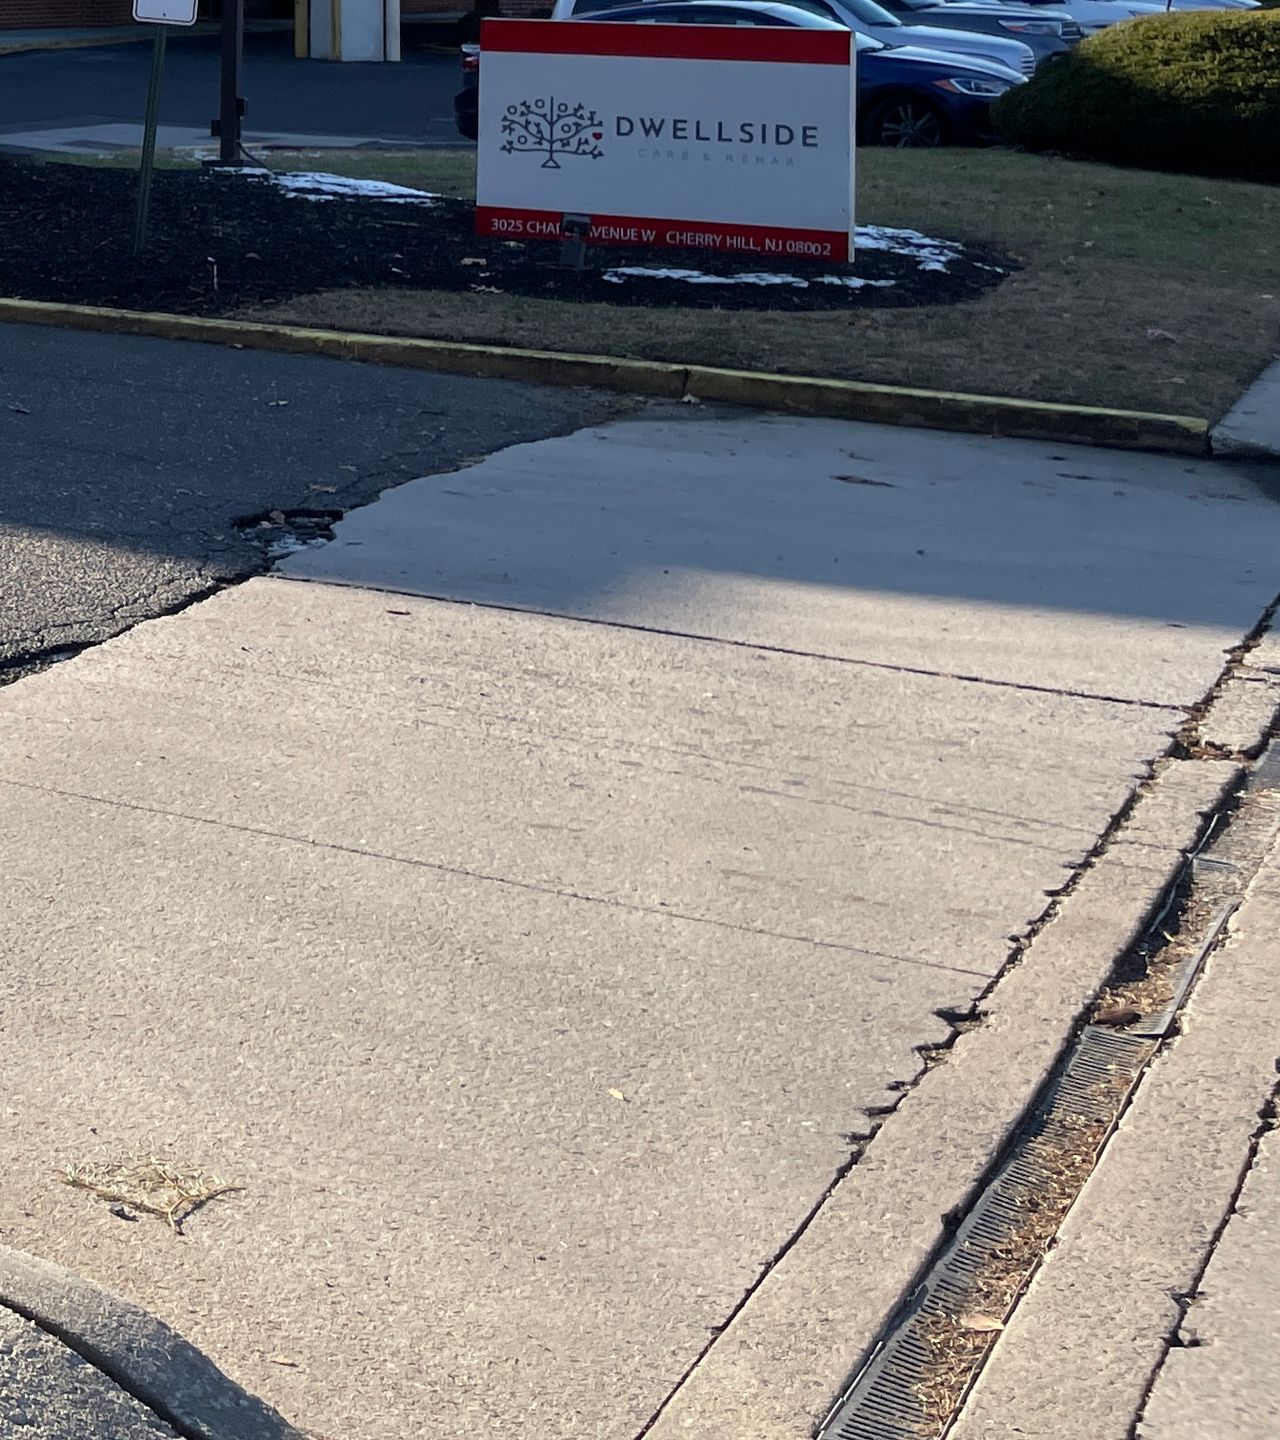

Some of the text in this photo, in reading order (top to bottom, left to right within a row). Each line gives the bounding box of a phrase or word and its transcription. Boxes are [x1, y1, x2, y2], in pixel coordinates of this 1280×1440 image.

[616, 115, 819, 148] DWELLSIDE
[637, 148, 690, 161] CARE
[726, 154, 794, 167] REHAB
[491, 218, 524, 233] 3025
[589, 225, 639, 242] VENUE
[641, 229, 656, 243] W
[666, 230, 723, 248] CHERRY
[726, 235, 762, 252] HILL,
[765, 238, 783, 253] NJ
[786, 240, 832, 256] 08002
